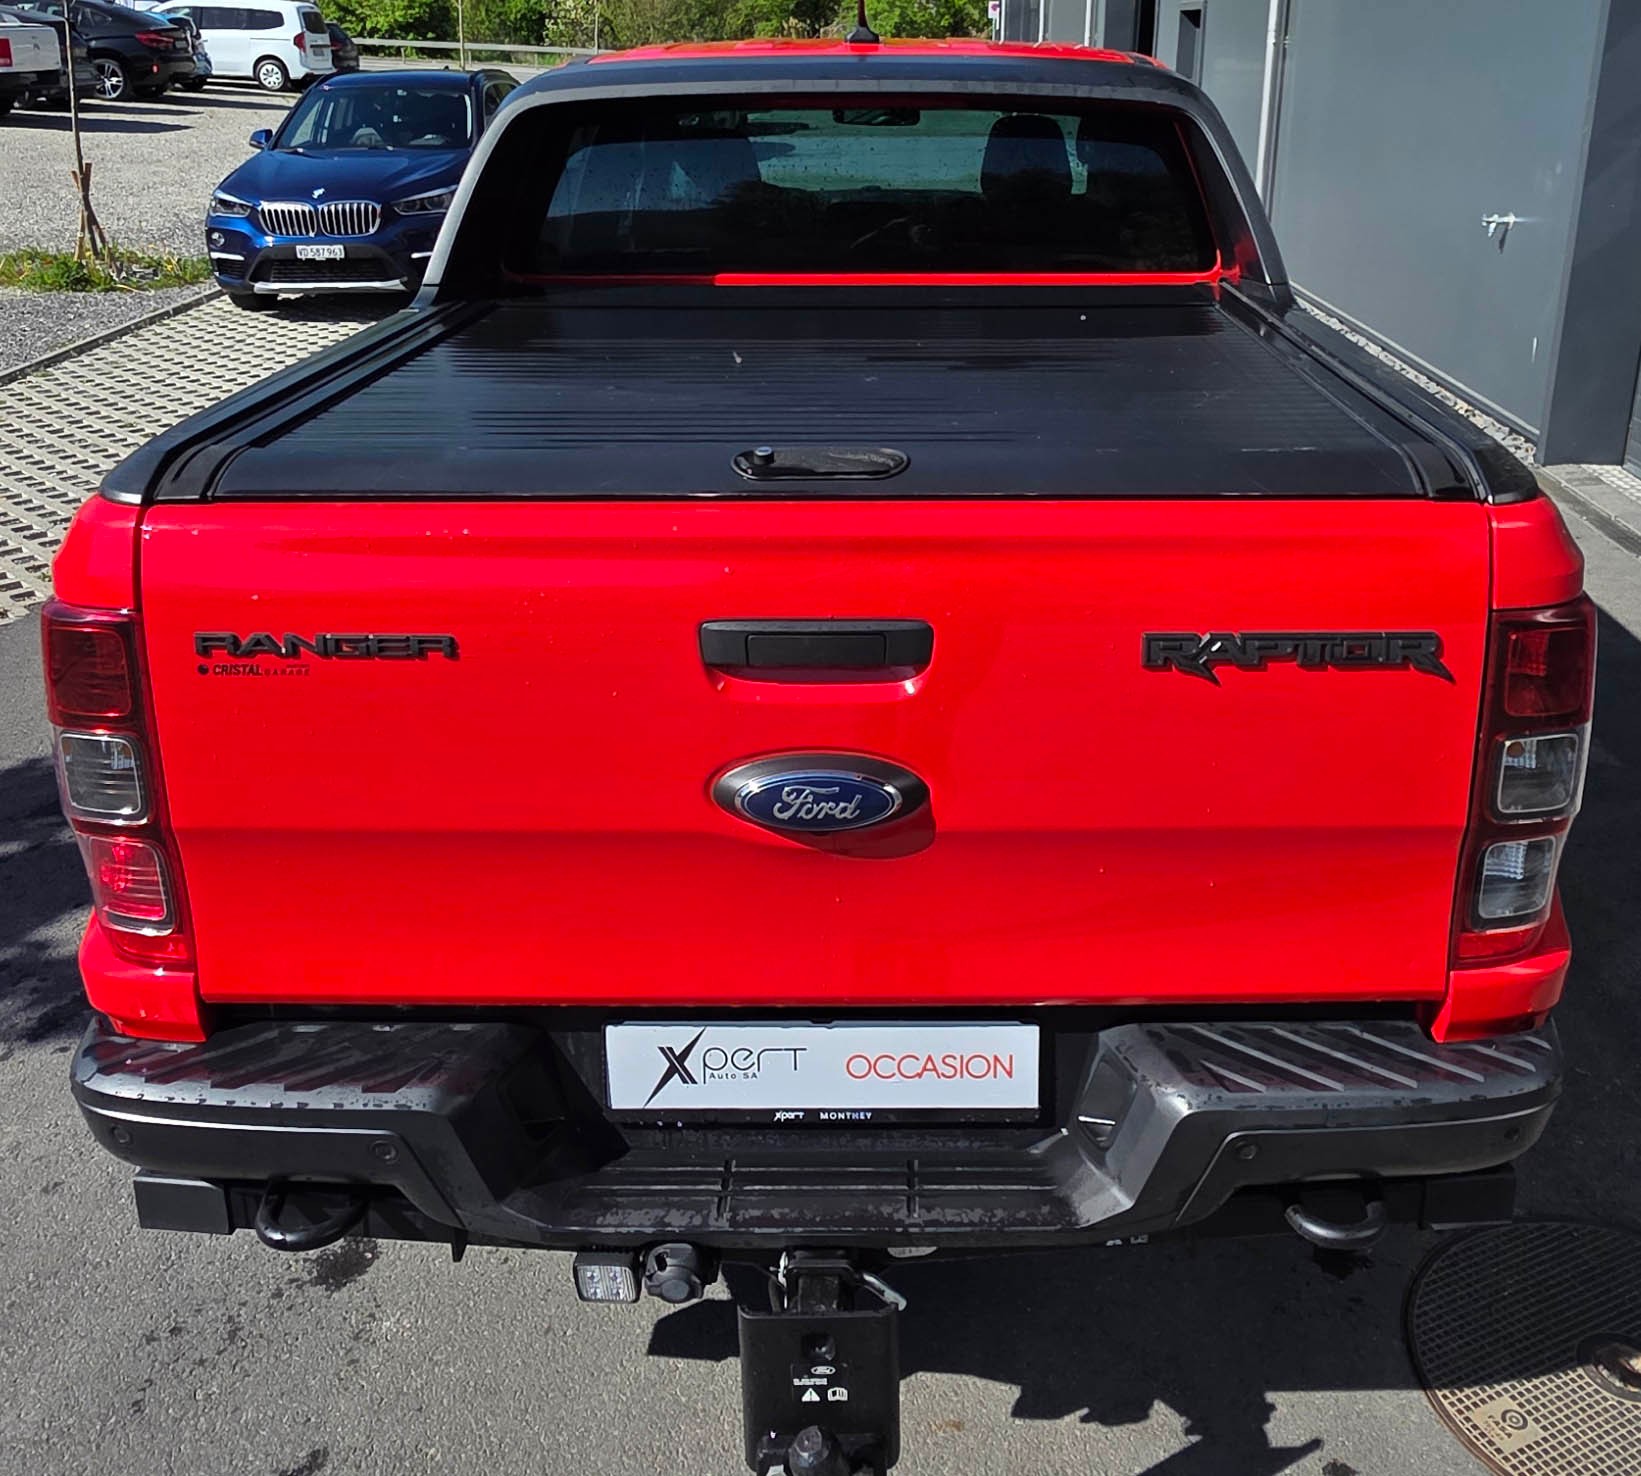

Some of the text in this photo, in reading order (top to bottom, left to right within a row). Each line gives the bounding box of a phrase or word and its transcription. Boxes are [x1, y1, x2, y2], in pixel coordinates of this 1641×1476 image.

[194, 631, 460, 661] RANGER
[1141, 631, 1456, 687] RAPTOR
[213, 663, 263, 677] CRISTAL
[773, 785, 862, 820] Ford
[709, 1072, 758, 1080] Auto SA
[845, 1053, 1014, 1080] OCCASION
[820, 1111, 872, 1120] MONTHEY
